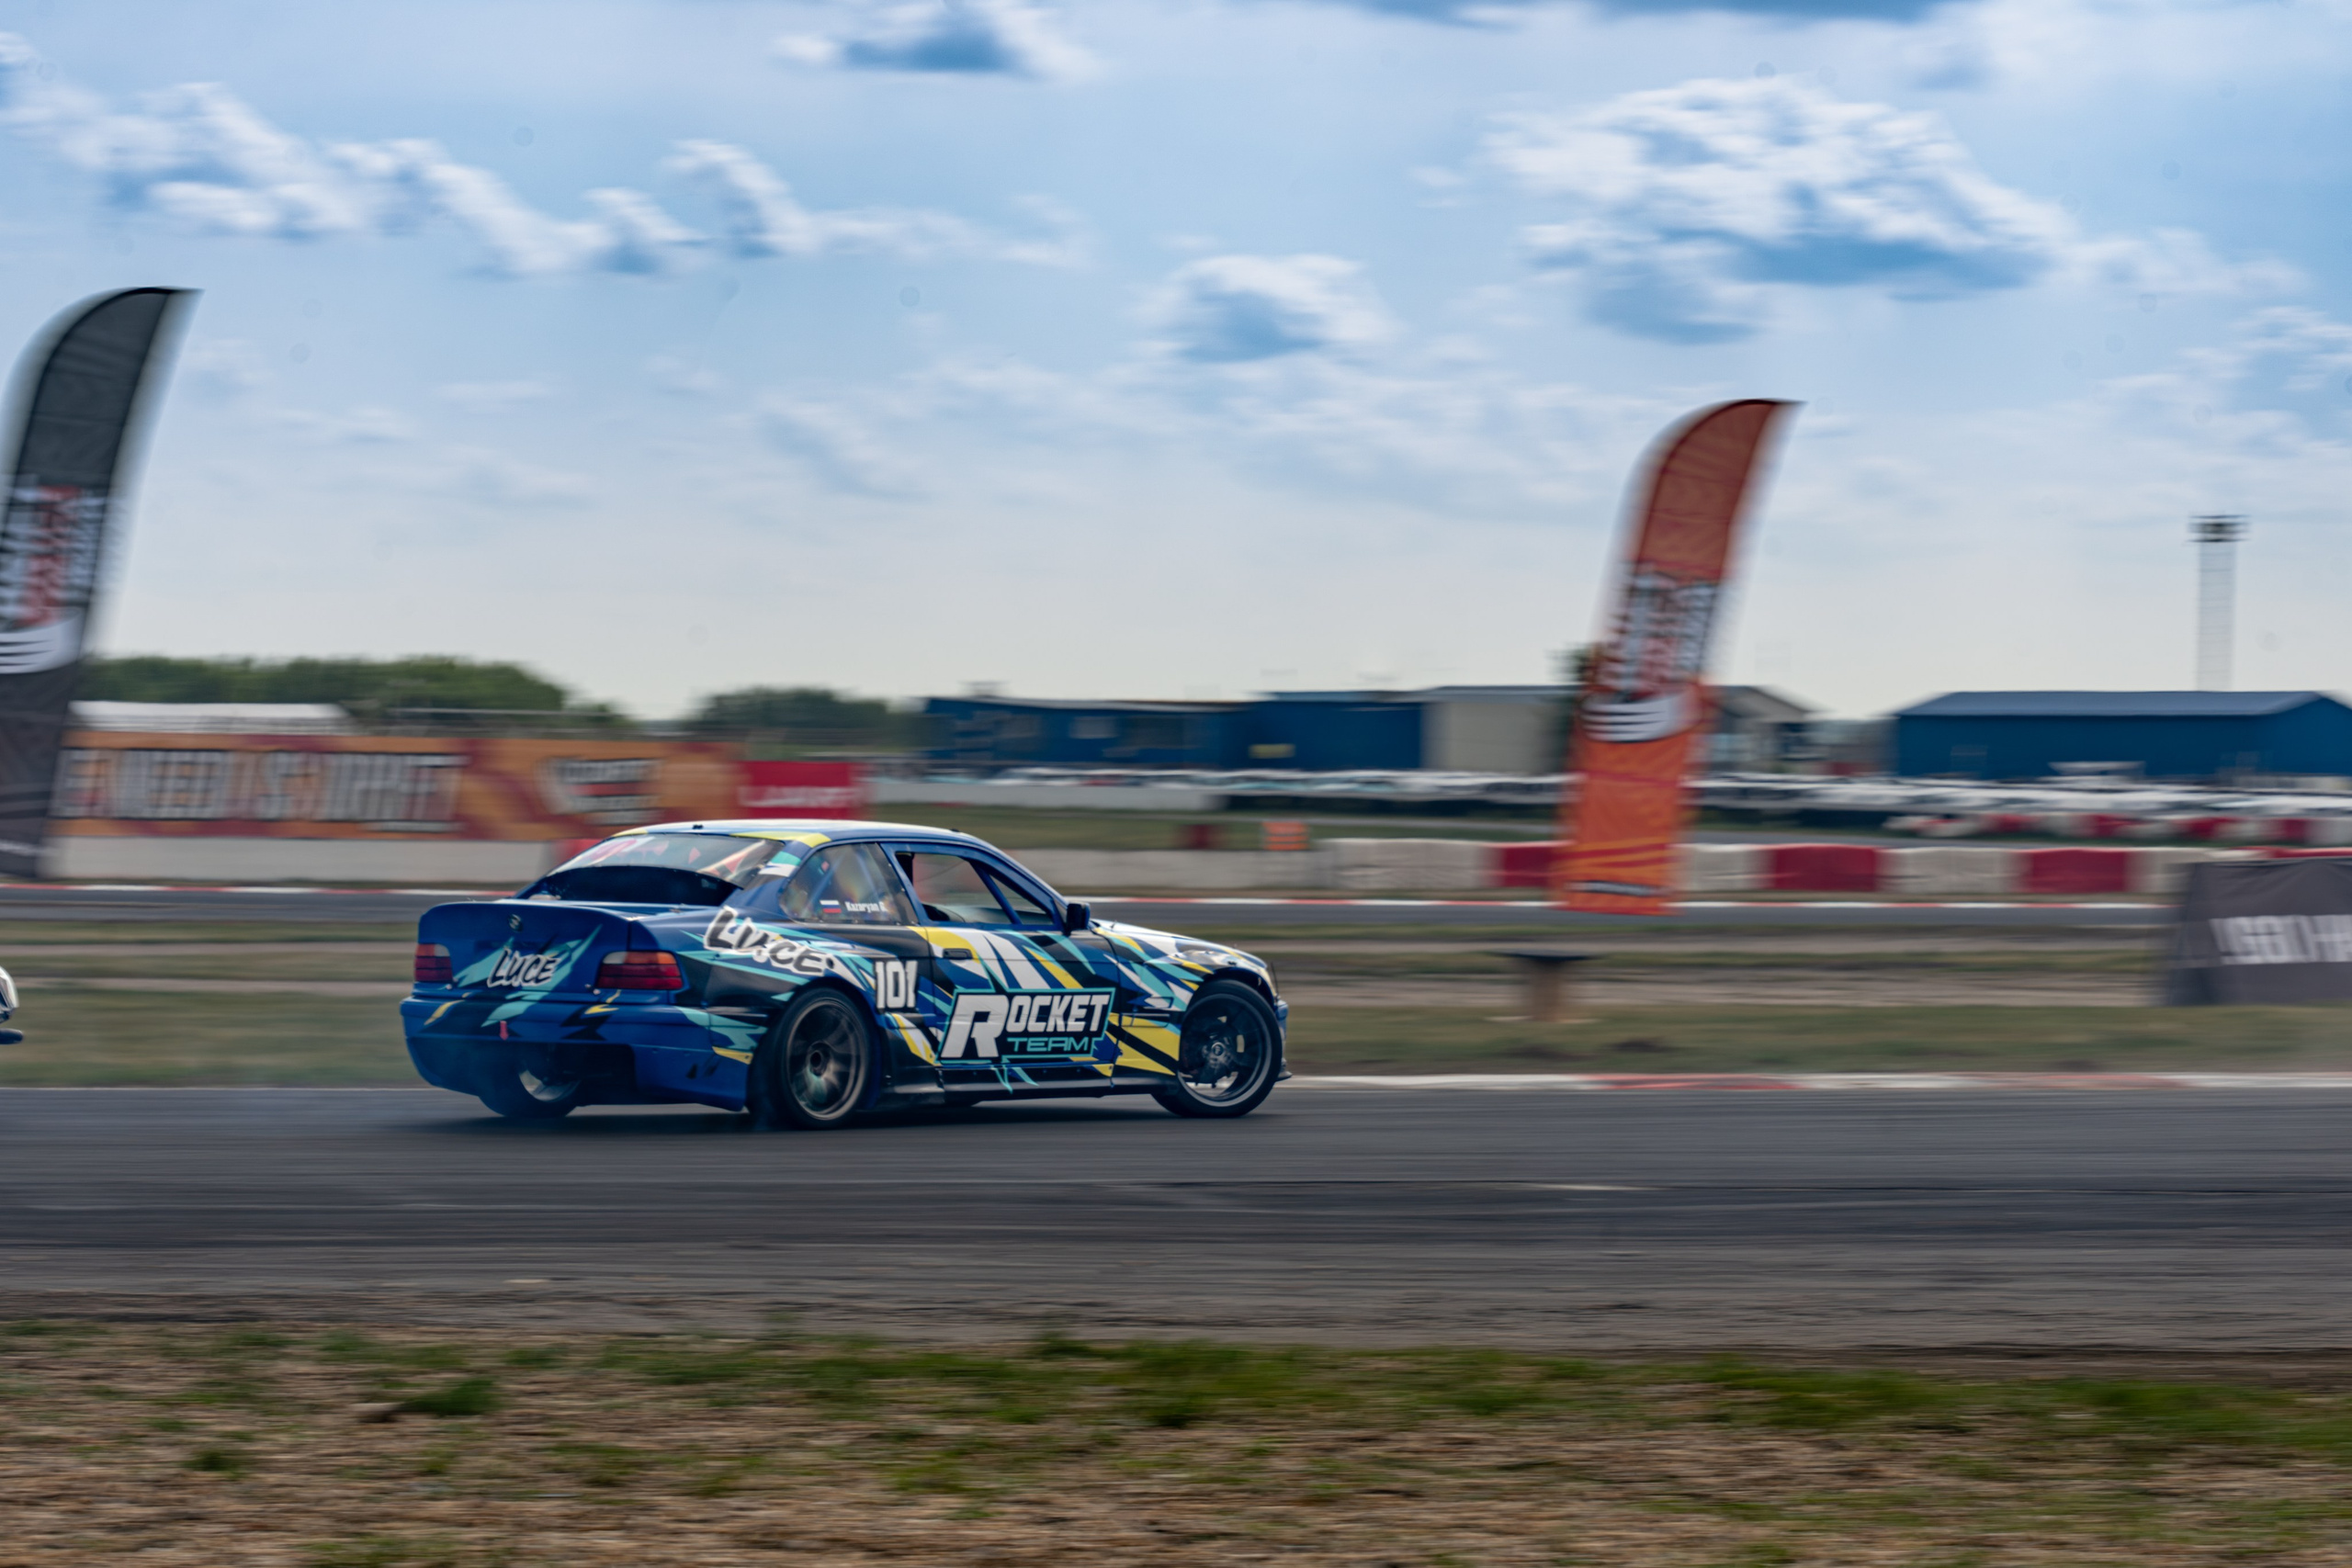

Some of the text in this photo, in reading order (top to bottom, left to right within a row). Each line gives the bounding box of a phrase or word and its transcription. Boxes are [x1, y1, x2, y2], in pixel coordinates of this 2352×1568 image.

[487, 946, 560, 987] LUCE
[875, 959, 918, 1010] 101
[940, 994, 1110, 1058] ROCKET
[1007, 1036, 1090, 1053] TEAM
